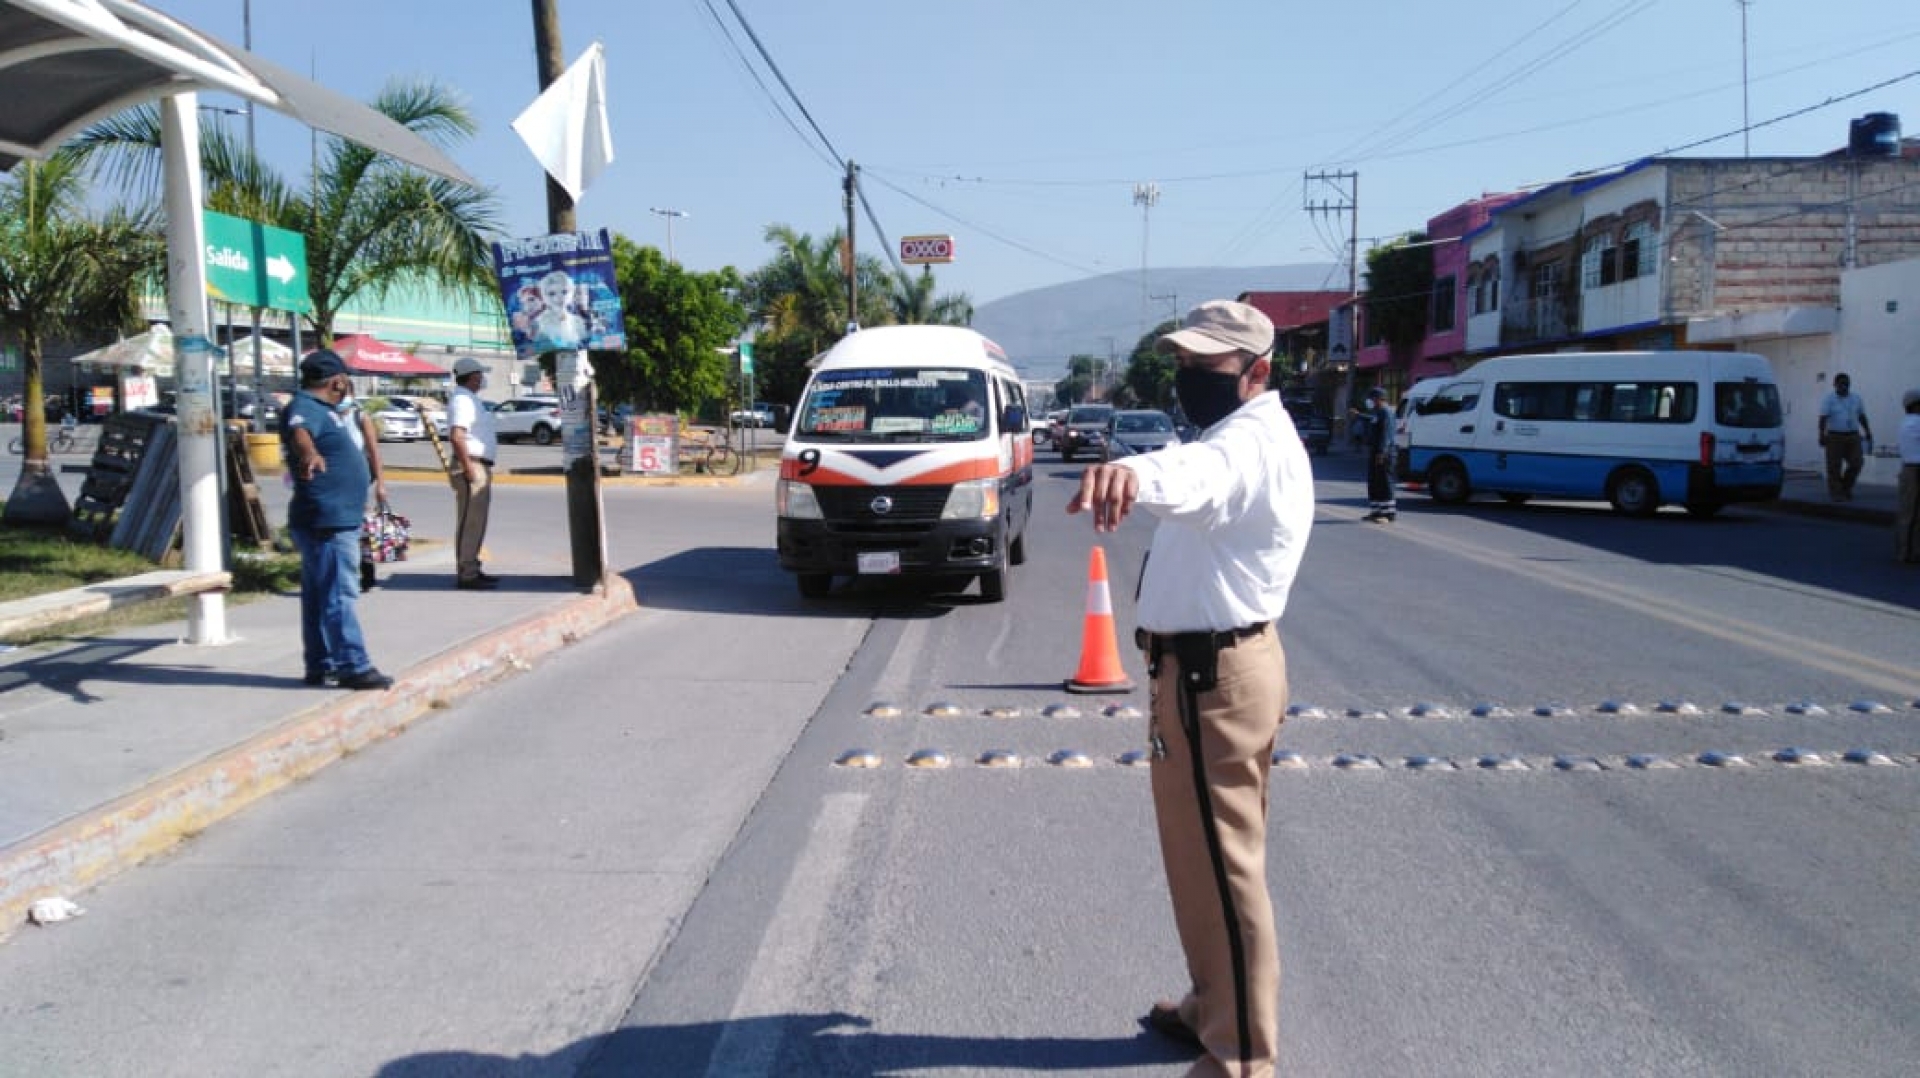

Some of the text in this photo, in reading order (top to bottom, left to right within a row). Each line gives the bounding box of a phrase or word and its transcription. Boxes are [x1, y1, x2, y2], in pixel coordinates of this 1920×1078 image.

[206, 245, 249, 272] Salida
[902, 241, 948, 258] OXXO
[797, 448, 821, 477] 9
